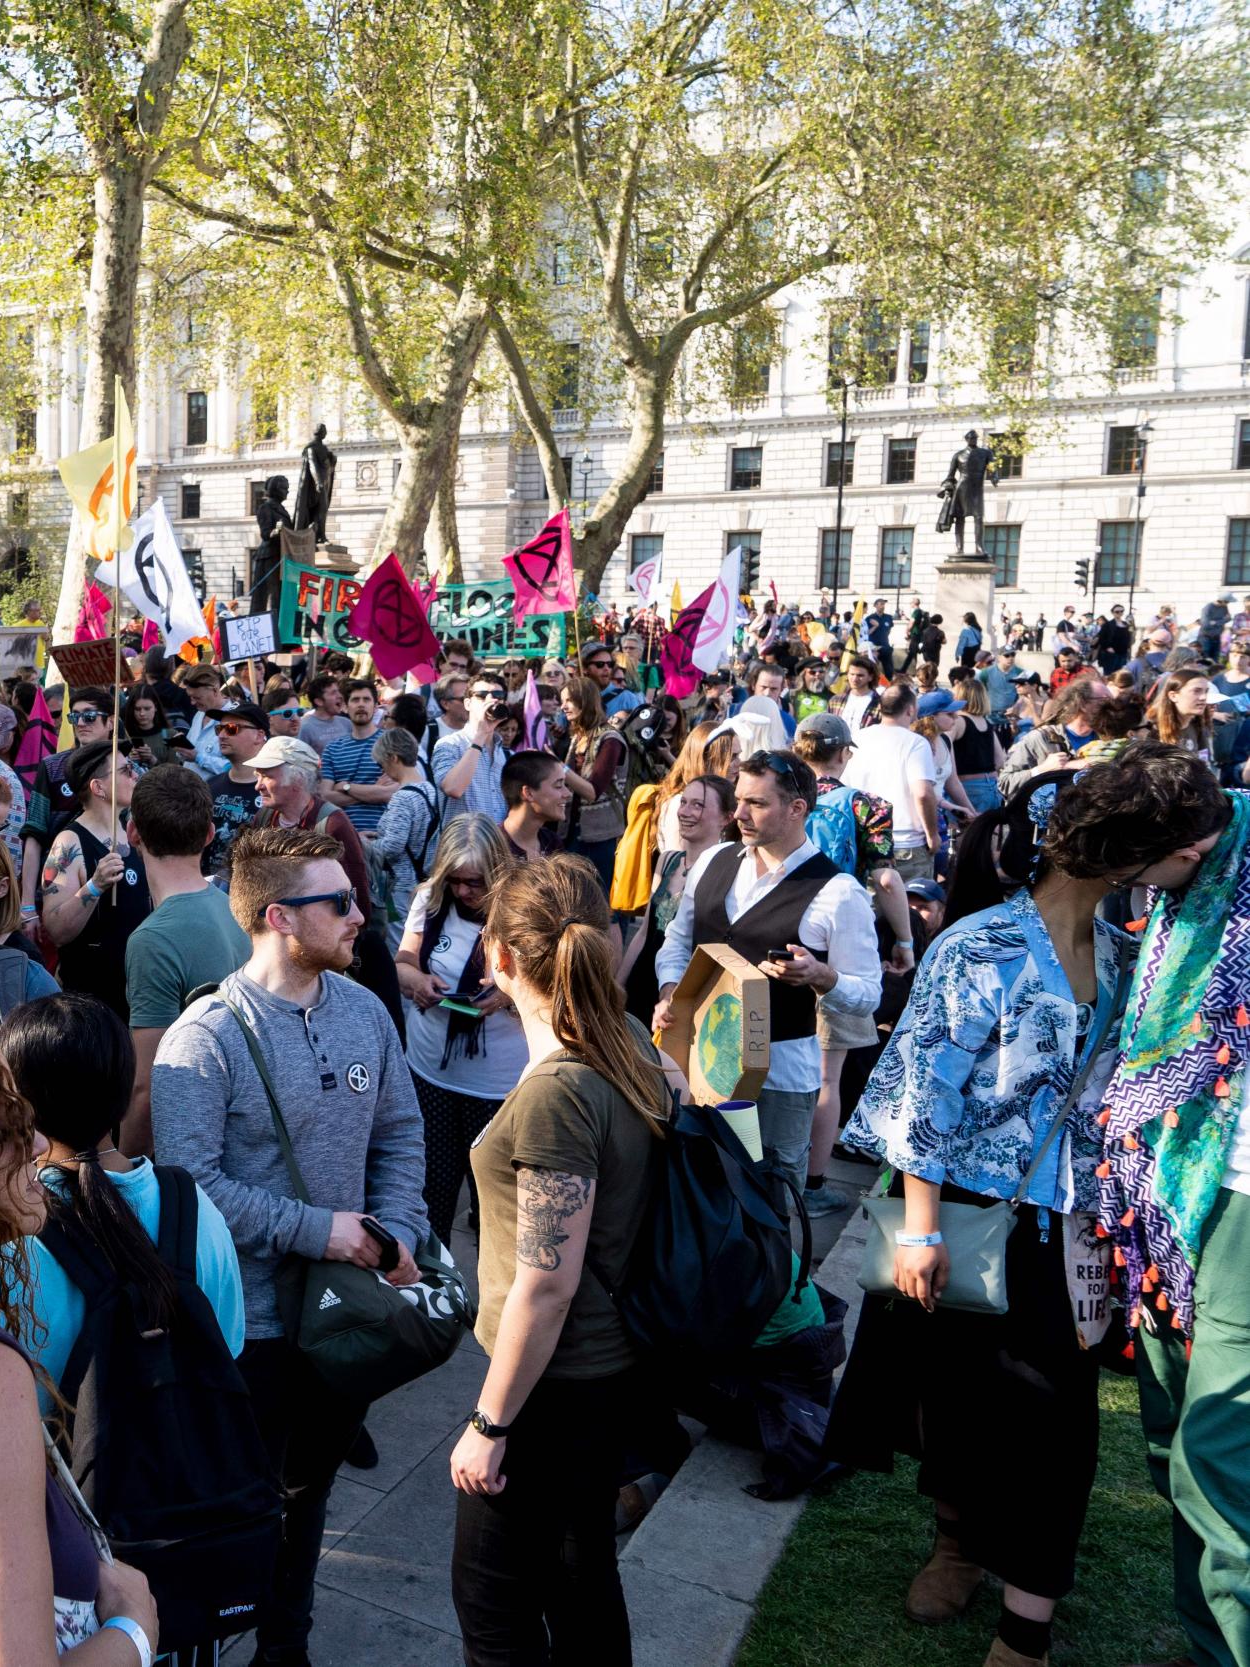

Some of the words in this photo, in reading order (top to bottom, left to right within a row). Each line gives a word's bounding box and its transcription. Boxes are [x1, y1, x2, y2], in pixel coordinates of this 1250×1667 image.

[297, 571, 364, 612] FIR
[430, 589, 516, 627] FLOO
[236, 616, 261, 634] RIP
[293, 610, 326, 640] IN
[240, 629, 259, 641] OUR
[51, 642, 116, 663] CLIMATE
[230, 635, 272, 658] PLANET
[749, 1011, 767, 1052] RIP
[1076, 1264, 1110, 1280] REBE
[319, 1297, 342, 1310] adidas
[219, 1603, 255, 1617] EASTPAK
